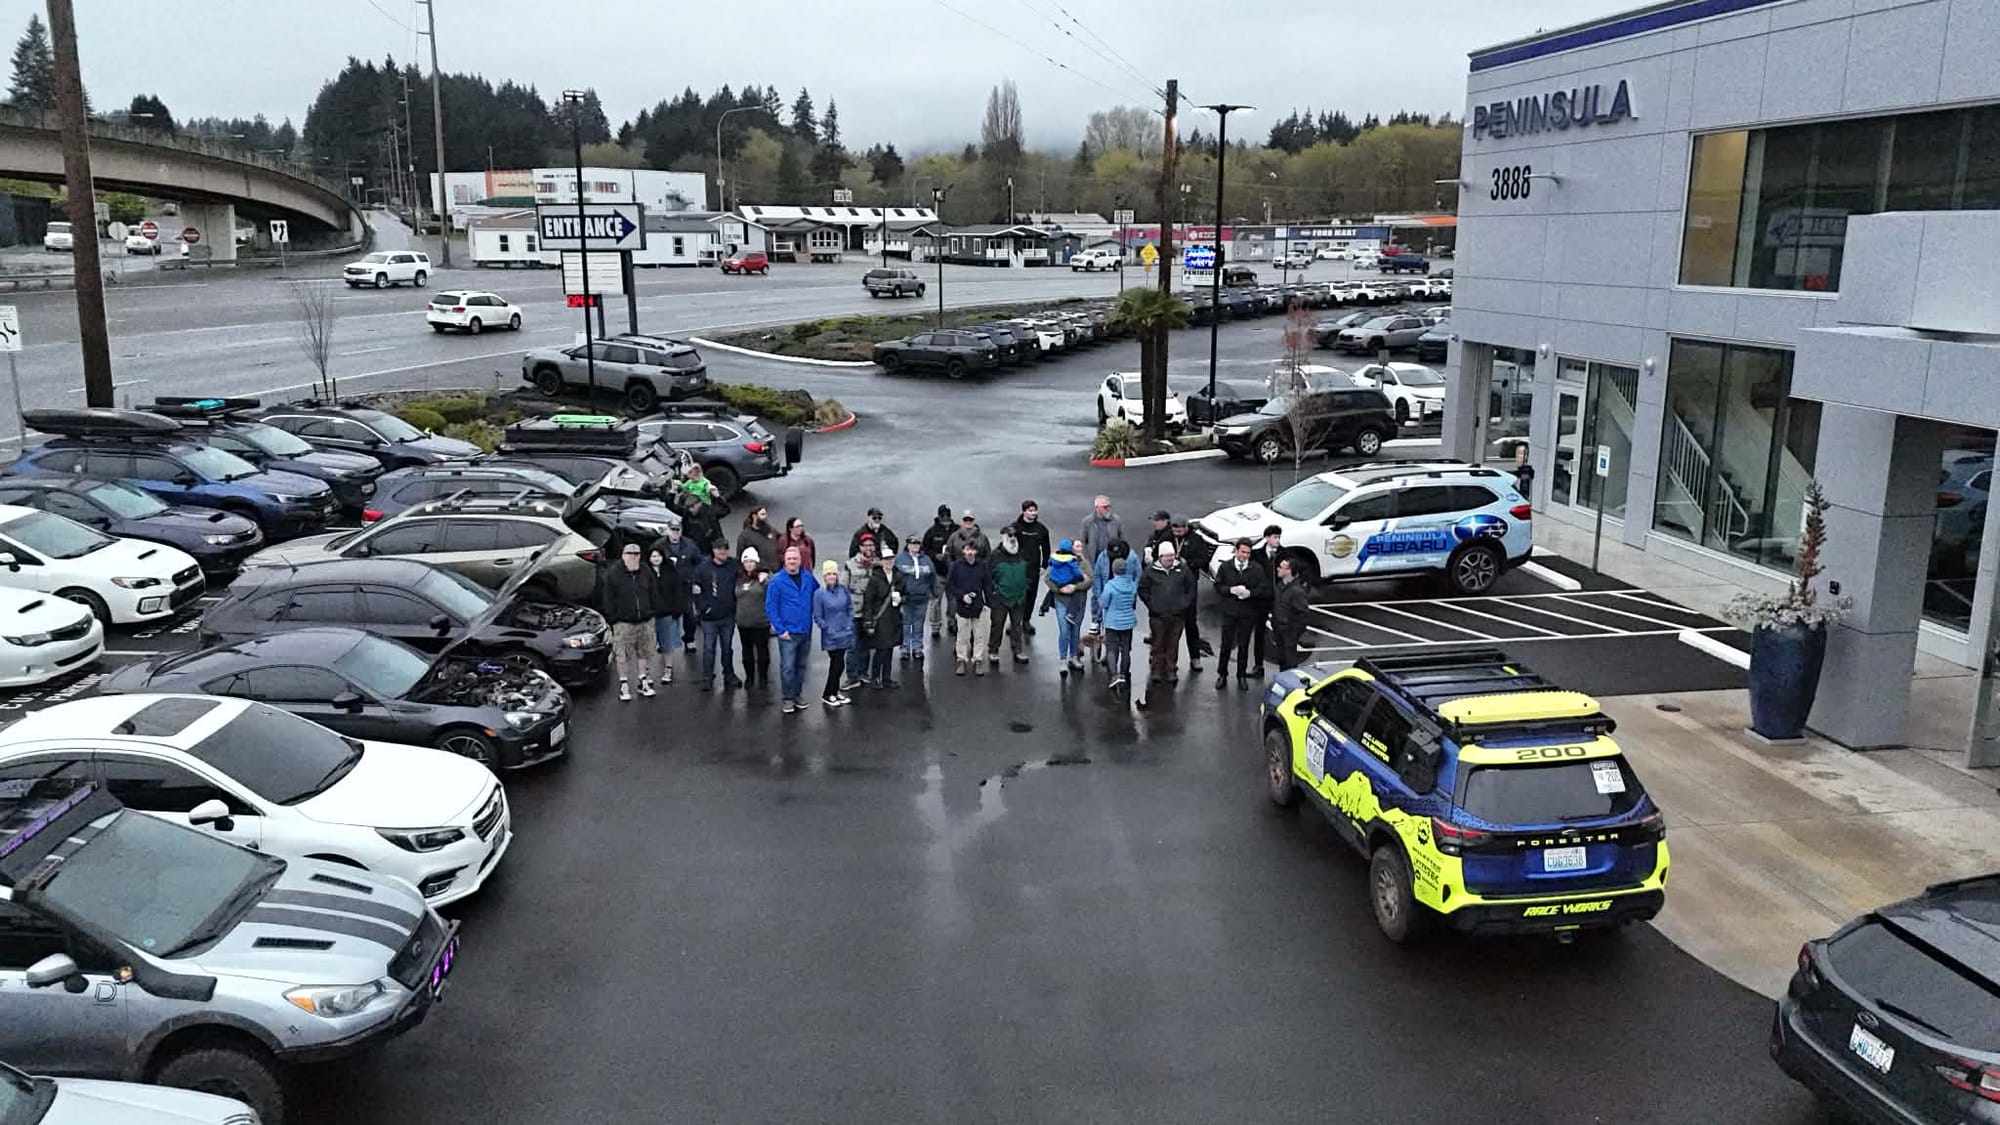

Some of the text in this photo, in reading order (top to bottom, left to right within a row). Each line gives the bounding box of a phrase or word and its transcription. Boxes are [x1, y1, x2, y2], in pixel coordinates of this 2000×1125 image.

[1473, 79, 1639, 140] PENINSULA
[1490, 165, 1532, 201] 3888
[544, 217, 624, 237] ENTRANCE
[1376, 532, 1448, 543] PENINSULA
[1366, 540, 1448, 556] SUBARU
[1516, 746, 1586, 761] 200
[1517, 833, 1619, 847] FORESTER
[1523, 900, 1614, 917] RACE WORKS
